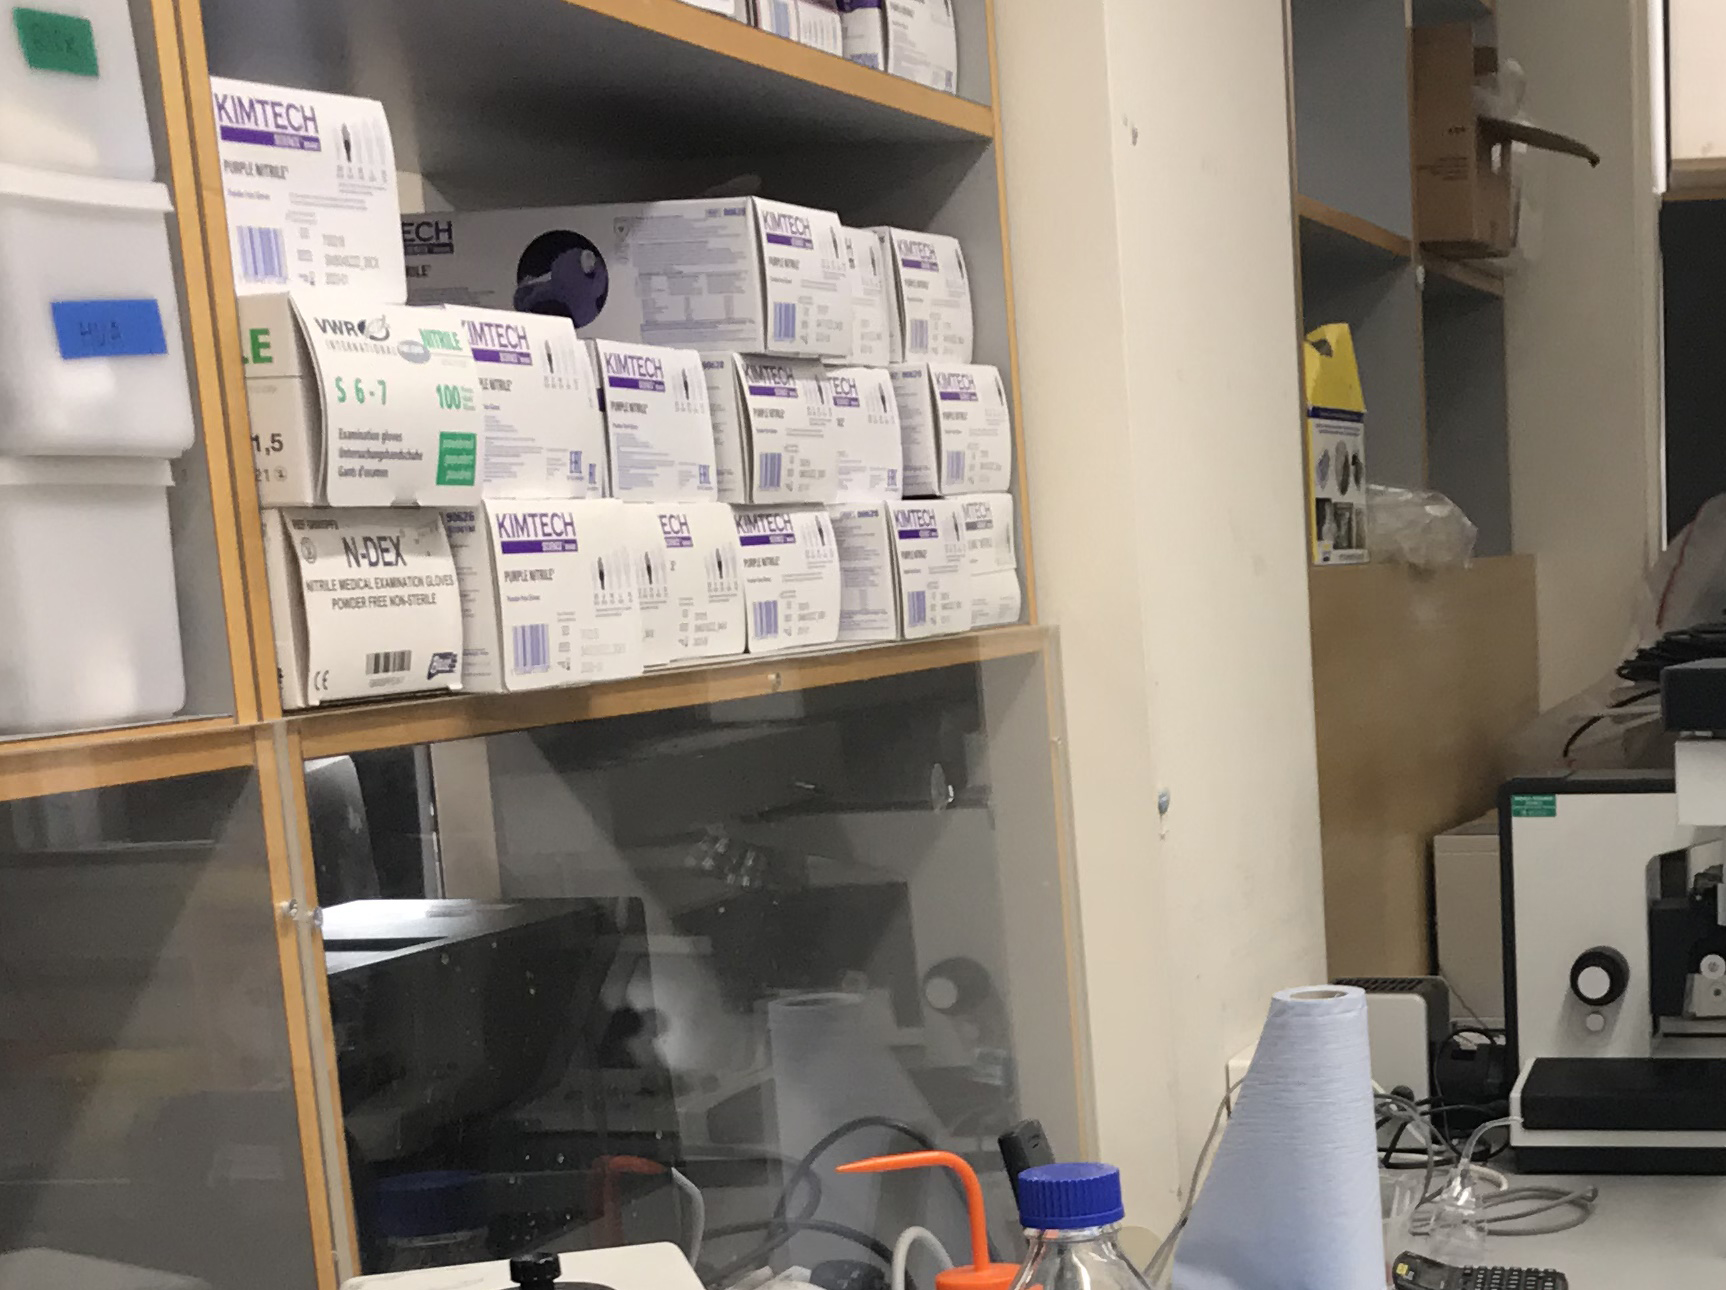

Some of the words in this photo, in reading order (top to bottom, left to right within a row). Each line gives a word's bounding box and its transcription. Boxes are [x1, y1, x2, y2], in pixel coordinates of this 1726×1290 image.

[214, 92, 319, 134] KIMTECH
[761, 209, 812, 237] KIMTECH
[313, 316, 358, 337] VWR
[461, 319, 531, 350] IMTECH
[603, 352, 664, 379] KIMTECH
[742, 363, 797, 386] KIMTECH
[436, 384, 461, 409] 100
[496, 512, 577, 538] KIMTECH
[657, 512, 692, 536] ECH
[733, 512, 794, 535] KIMTECH
[893, 508, 938, 529] KIMTECH
[342, 535, 407, 568] N-DEX
[306, 579, 337, 592] NITRILE
[338, 577, 374, 591] MEDICAL
[374, 575, 424, 589] EXAMINATION
[425, 574, 455, 587] GLOVES
[332, 596, 366, 610] POWDER
[368, 595, 388, 608] FREE
